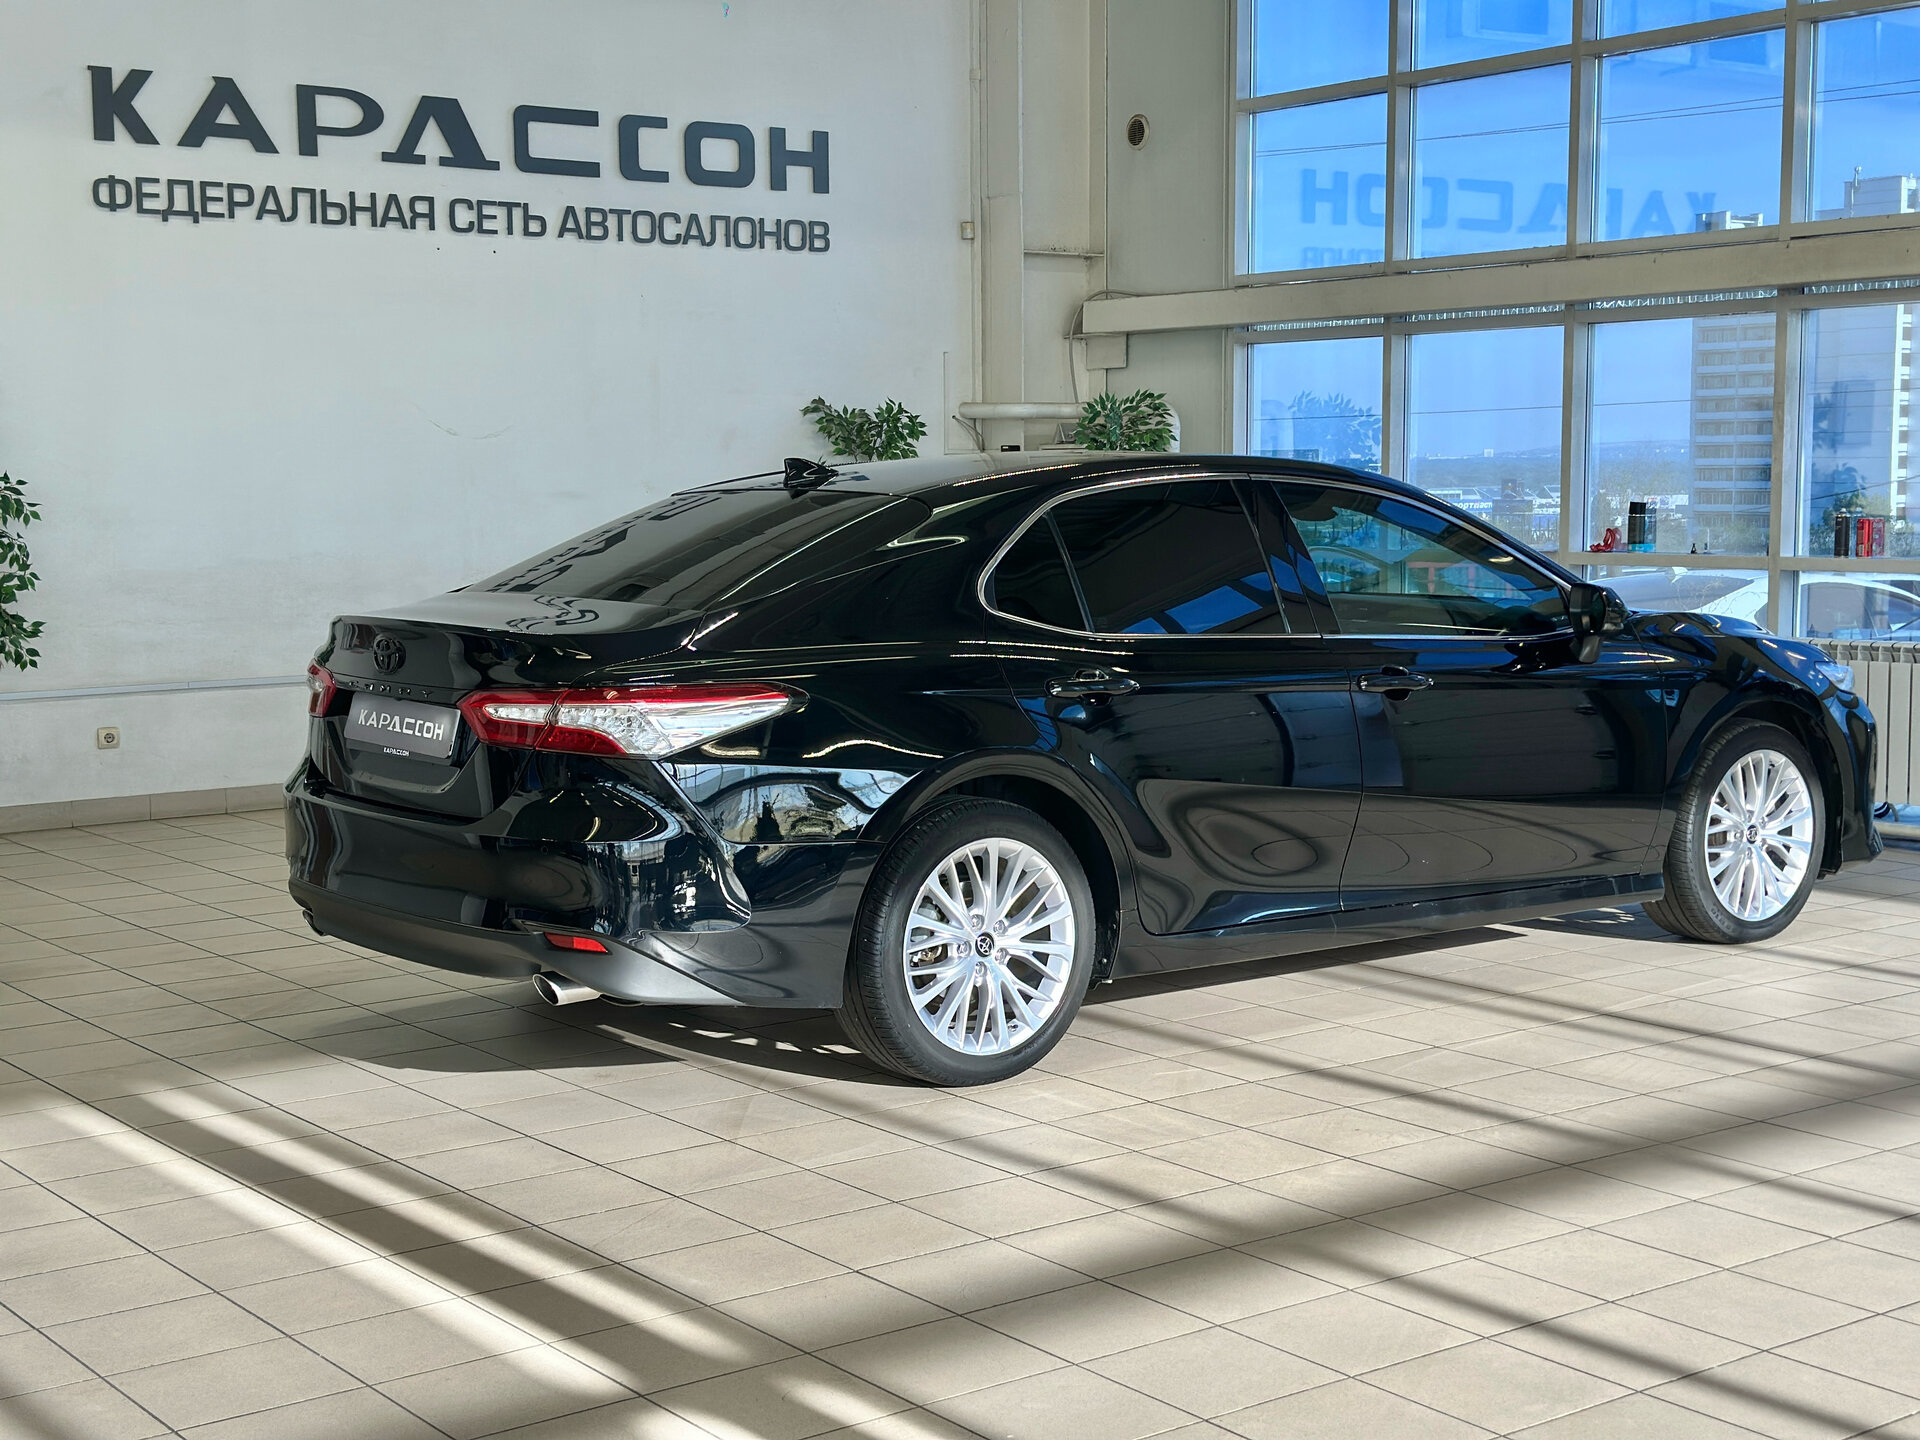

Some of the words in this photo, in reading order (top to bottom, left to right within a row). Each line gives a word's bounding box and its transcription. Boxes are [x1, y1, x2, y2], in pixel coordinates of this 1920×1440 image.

[92, 175, 436, 230] ФЕДЕРАЛЬНАЯ
[449, 198, 547, 238] СЕТЬ
[558, 206, 831, 253] АВТОСАЛОНОВ
